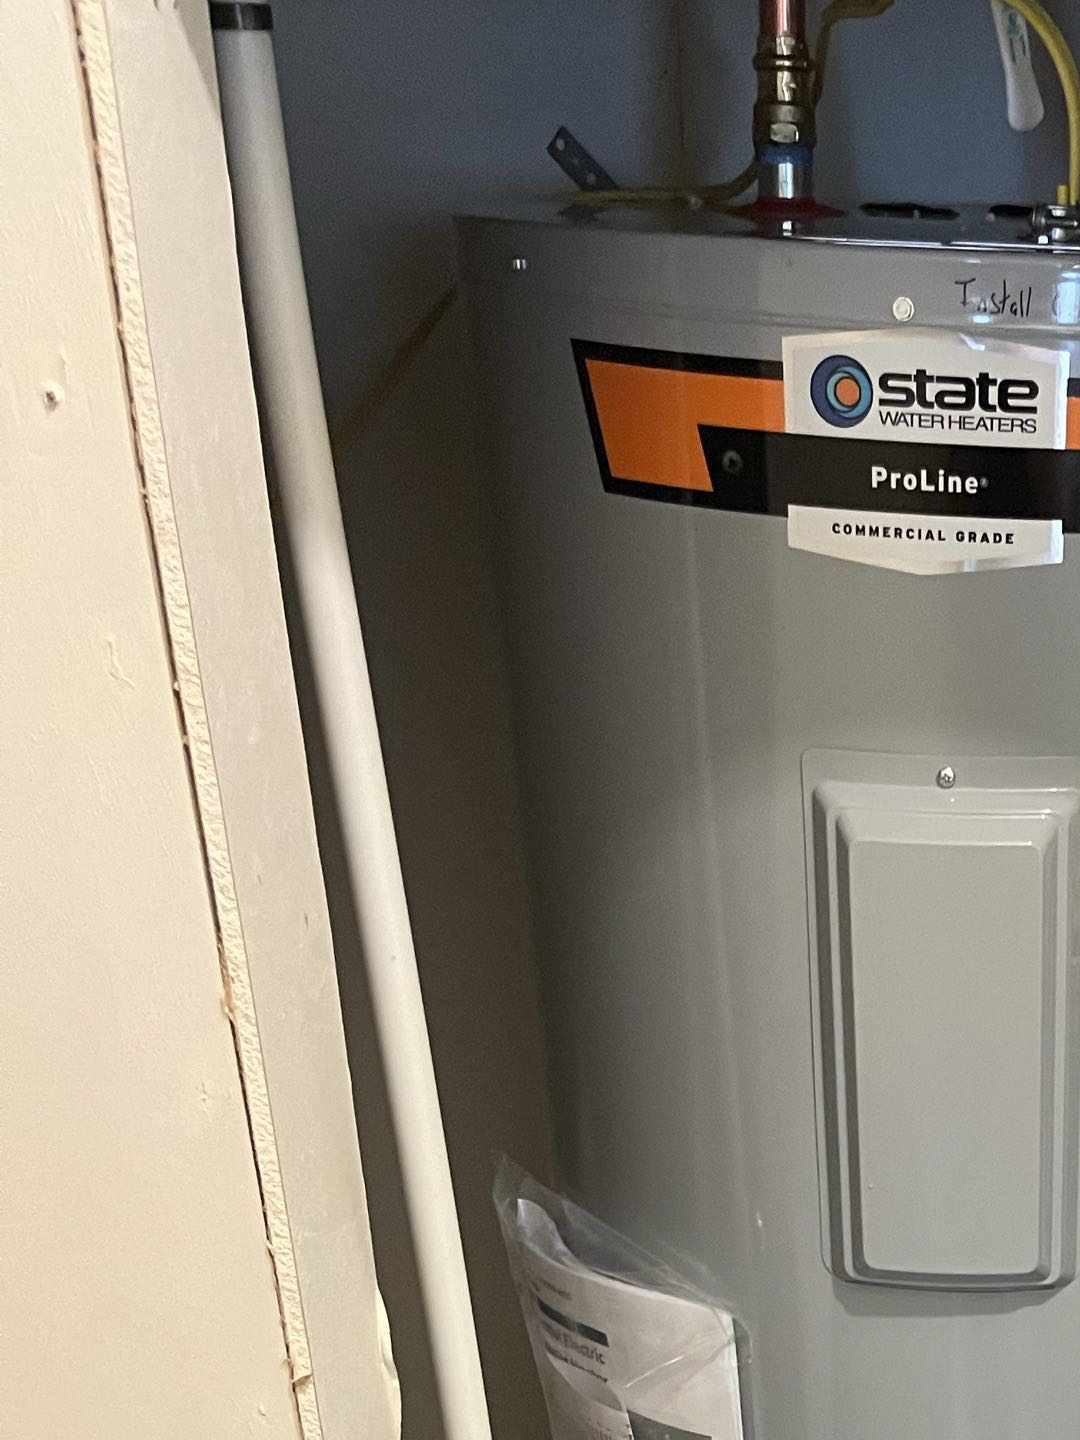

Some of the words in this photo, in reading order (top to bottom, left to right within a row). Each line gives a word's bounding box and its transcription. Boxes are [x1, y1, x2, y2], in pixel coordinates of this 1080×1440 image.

[954, 278, 1032, 318] Install
[878, 368, 1039, 414] state
[879, 410, 945, 430] WATER
[948, 414, 1038, 434] HEATERS
[831, 522, 946, 542] COMMERCIAL
[955, 531, 1015, 545] GRADE
